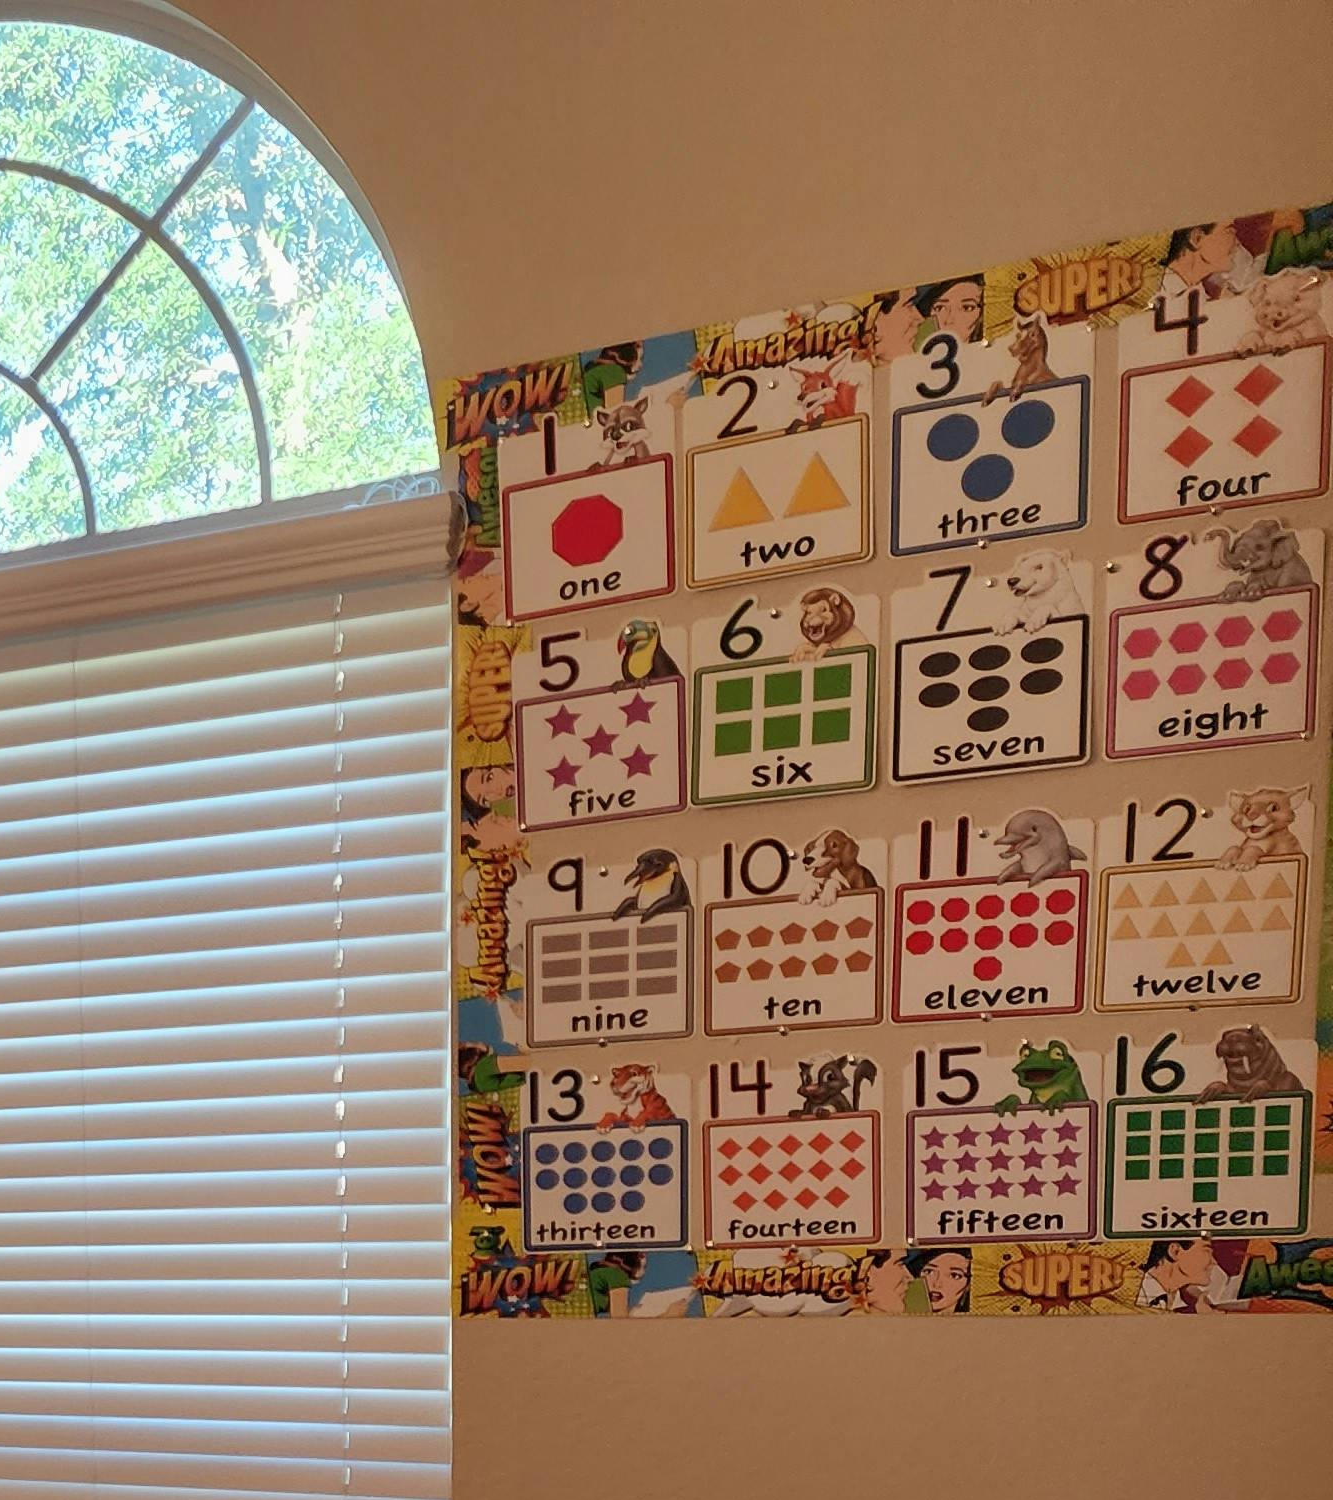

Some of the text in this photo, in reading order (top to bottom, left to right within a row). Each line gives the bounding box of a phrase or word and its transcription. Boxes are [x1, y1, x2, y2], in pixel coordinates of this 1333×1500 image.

[707, 300, 883, 376] Amazing!
[1154, 291, 1209, 355] 4
[915, 333, 961, 399] 3
[447, 361, 573, 446] WOW!
[716, 375, 758, 439] 2
[543, 416, 556, 475] 1
[1177, 470, 1271, 506] four
[938, 504, 1042, 539] three
[740, 535, 816, 567] two
[1139, 533, 1190, 600] 8
[559, 570, 622, 600] one
[929, 564, 972, 631] 7
[719, 599, 764, 660] 6
[539, 631, 581, 691] 5
[1158, 701, 1269, 741] eight
[751, 755, 814, 787] six
[932, 734, 1045, 765] seven
[569, 788, 637, 816] five
[919, 816, 970, 880] 11
[1126, 798, 1198, 863] 12
[547, 857, 584, 911] 9
[723, 837, 790, 899] 10
[763, 995, 823, 1020] ten
[924, 984, 1050, 1011] eleven
[1132, 969, 1263, 997] twelve
[571, 1005, 649, 1033] nine
[709, 1058, 773, 1119] 14
[914, 1046, 982, 1107] 15
[1116, 1032, 1186, 1096] 16
[529, 1068, 586, 1125] 13
[466, 1101, 521, 1209] WOW!
[536, 1219, 657, 1242] thirteen
[728, 1218, 858, 1241] fourteen
[937, 1209, 1065, 1235] fifteen
[1141, 1206, 1269, 1230] sixteen
[462, 1257, 580, 1313] WOW!
[704, 1252, 876, 1303] Amazing!
[1002, 1254, 1125, 1298] SUPER!
